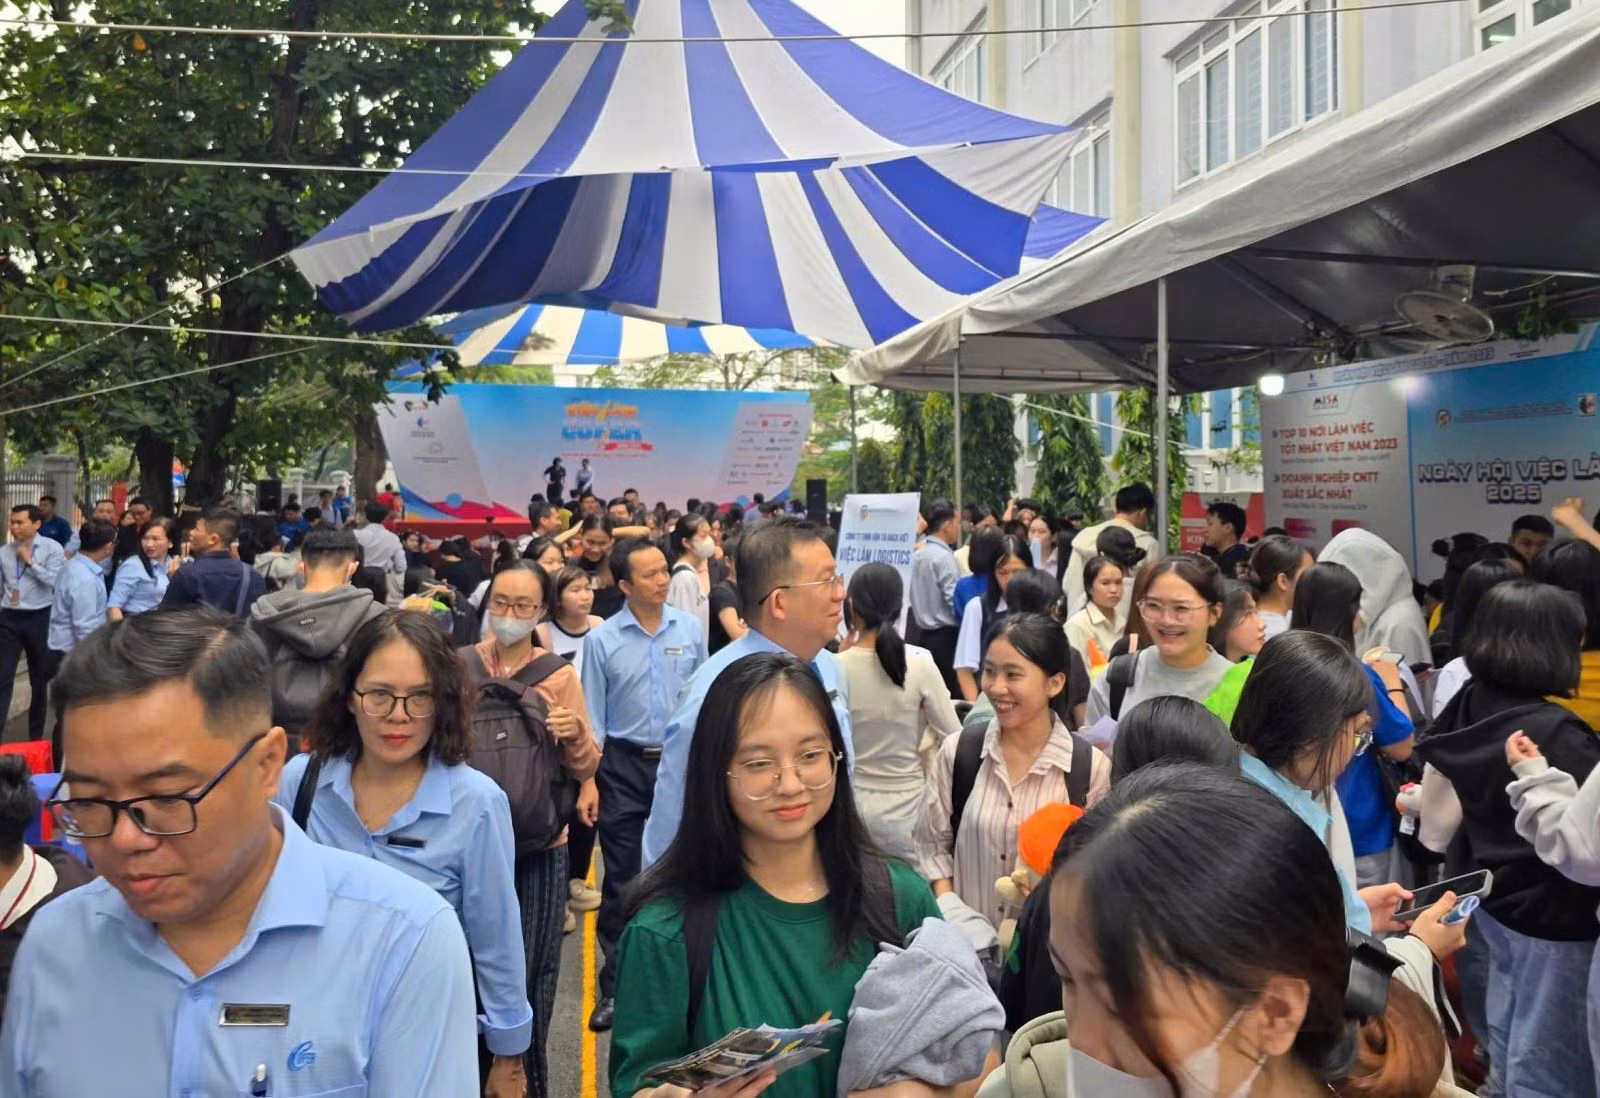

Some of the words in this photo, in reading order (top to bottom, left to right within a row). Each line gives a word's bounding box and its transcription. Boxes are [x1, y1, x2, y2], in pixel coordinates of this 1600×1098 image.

[1280, 428, 1296, 438] TOP
[1298, 428, 1307, 437] 10
[1310, 426, 1326, 437] NƠI
[1328, 424, 1348, 436] LÀM
[1351, 421, 1375, 434] VIỆC
[1280, 442, 1296, 454] TỐT
[1298, 441, 1322, 454] NHẤT
[1325, 440, 1345, 453] VIỆT
[1348, 440, 1371, 451] NAM
[1373, 438, 1398, 450] 2023
[1281, 472, 1313, 483] DOANH
[1315, 469, 1350, 483] NGHIỆP
[1353, 471, 1379, 483] CNTT
[1418, 459, 1472, 483] NGÀY
[1477, 457, 1512, 485] HỘI
[1516, 455, 1568, 485] VIỆC
[1573, 452, 1600, 480] LÀ
[1327, 486, 1353, 499] NHẤT
[1487, 484, 1542, 504] 2025
[839, 545, 856, 563] VIỆC
[856, 546, 872, 562] LÀM
[873, 549, 911, 565] LOGISTICS
